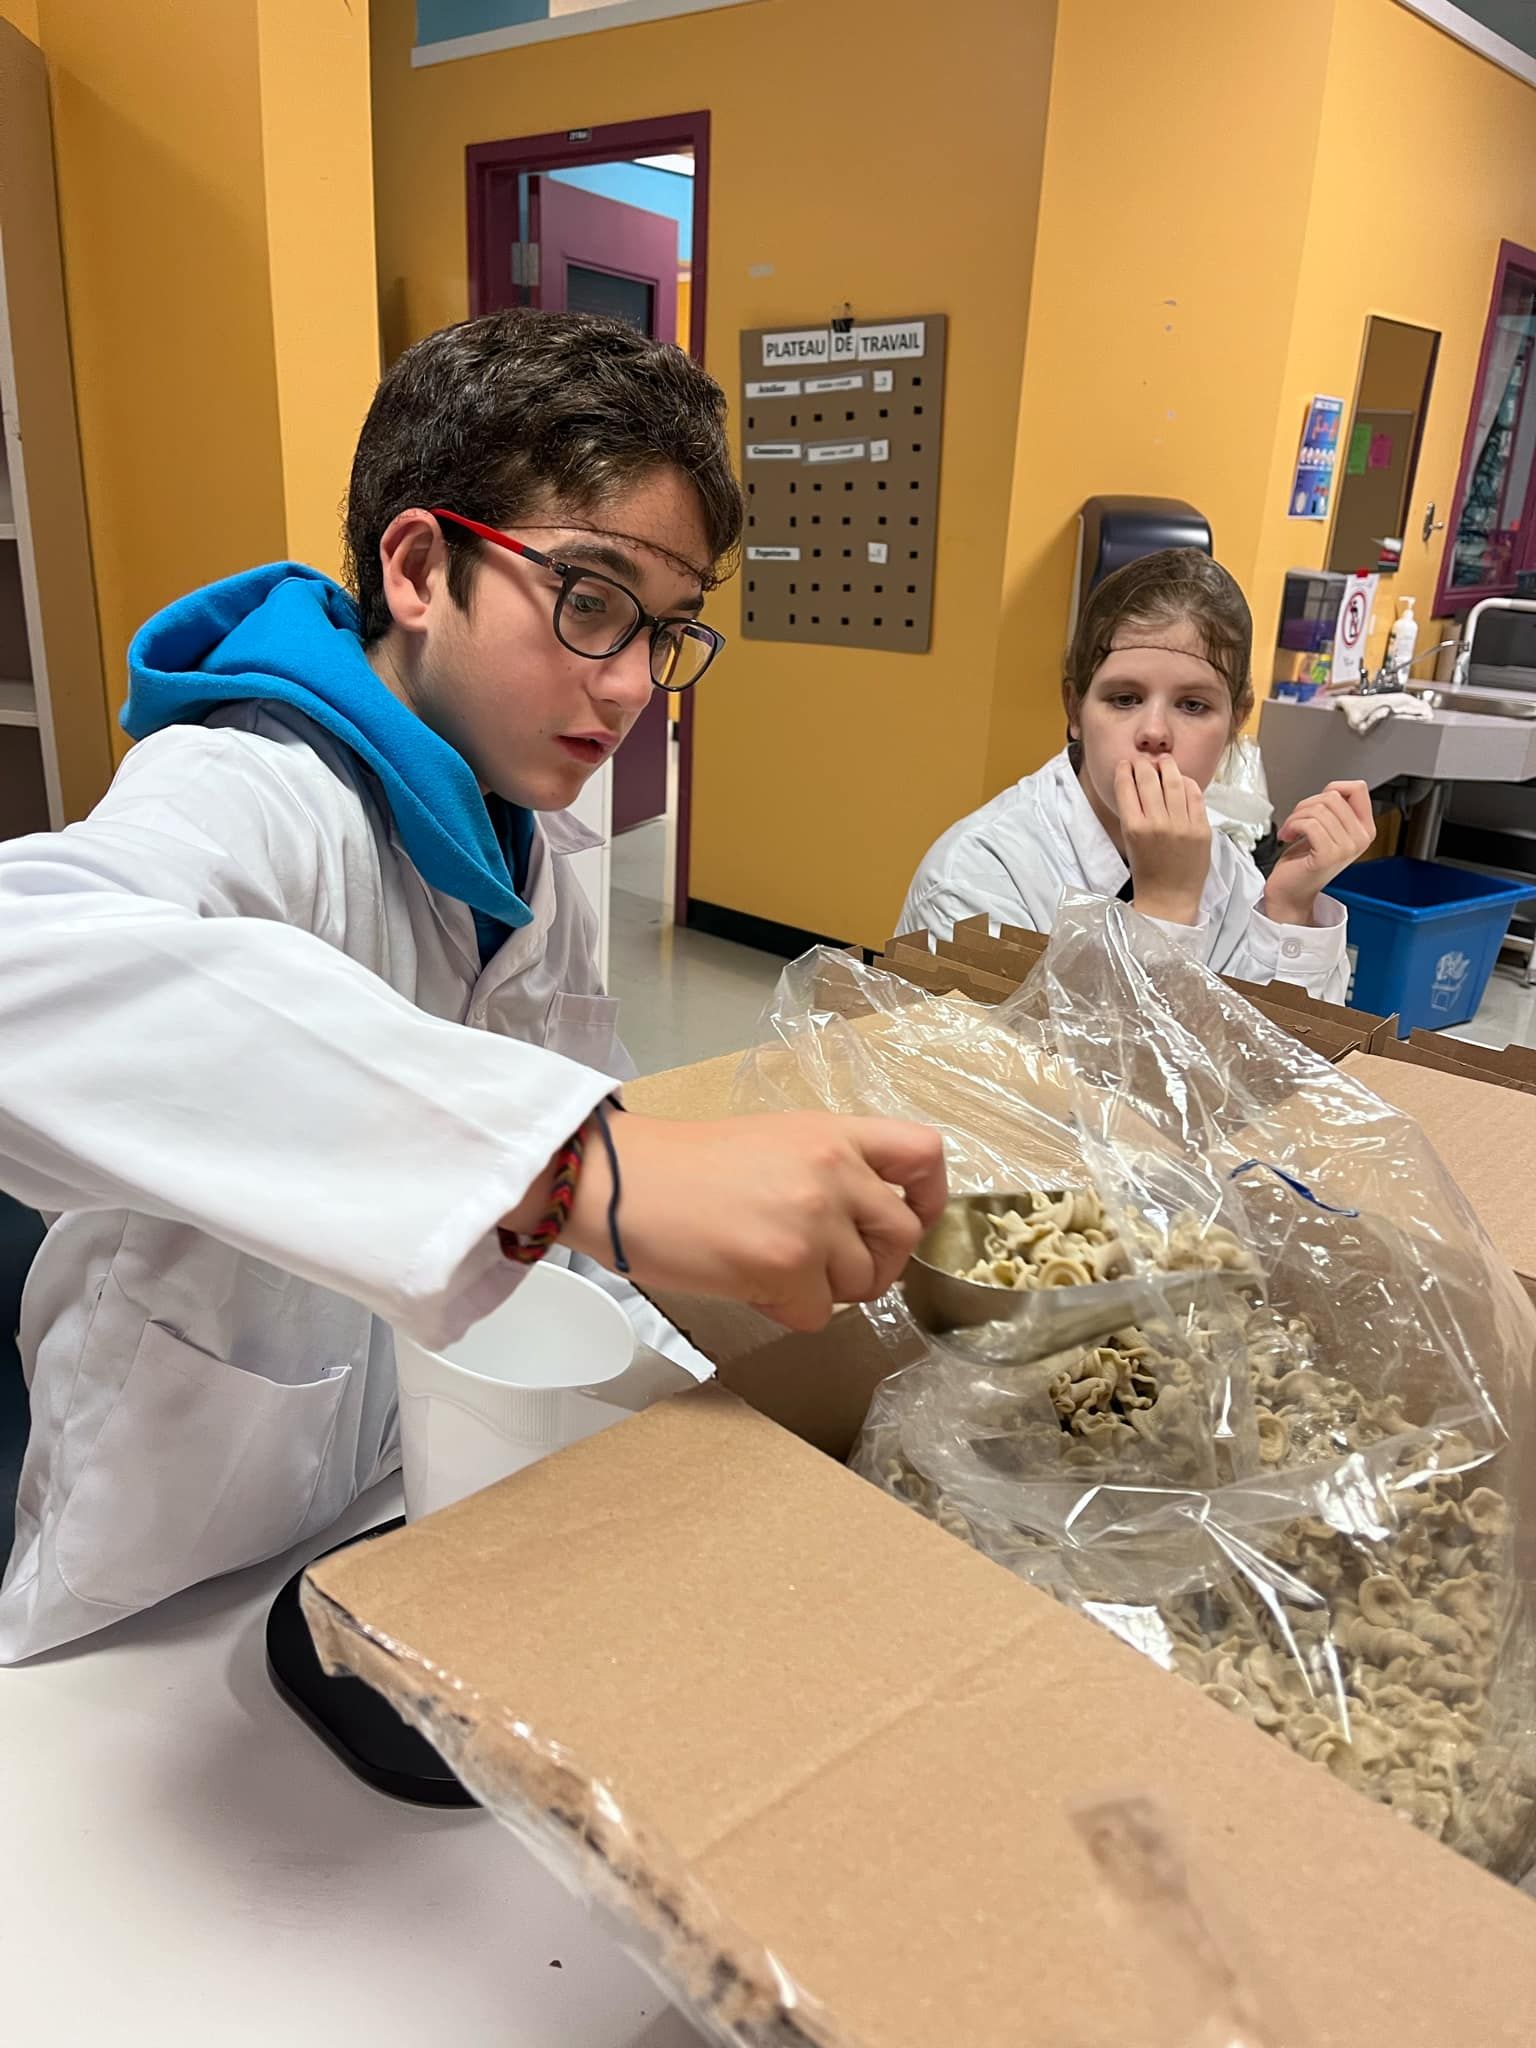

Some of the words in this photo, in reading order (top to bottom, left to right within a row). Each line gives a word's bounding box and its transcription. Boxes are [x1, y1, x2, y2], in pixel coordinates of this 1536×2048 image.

[766, 339, 826, 358] PLATEAU
[835, 336, 853, 353] DE
[862, 333, 920, 353] TRAVAIL
